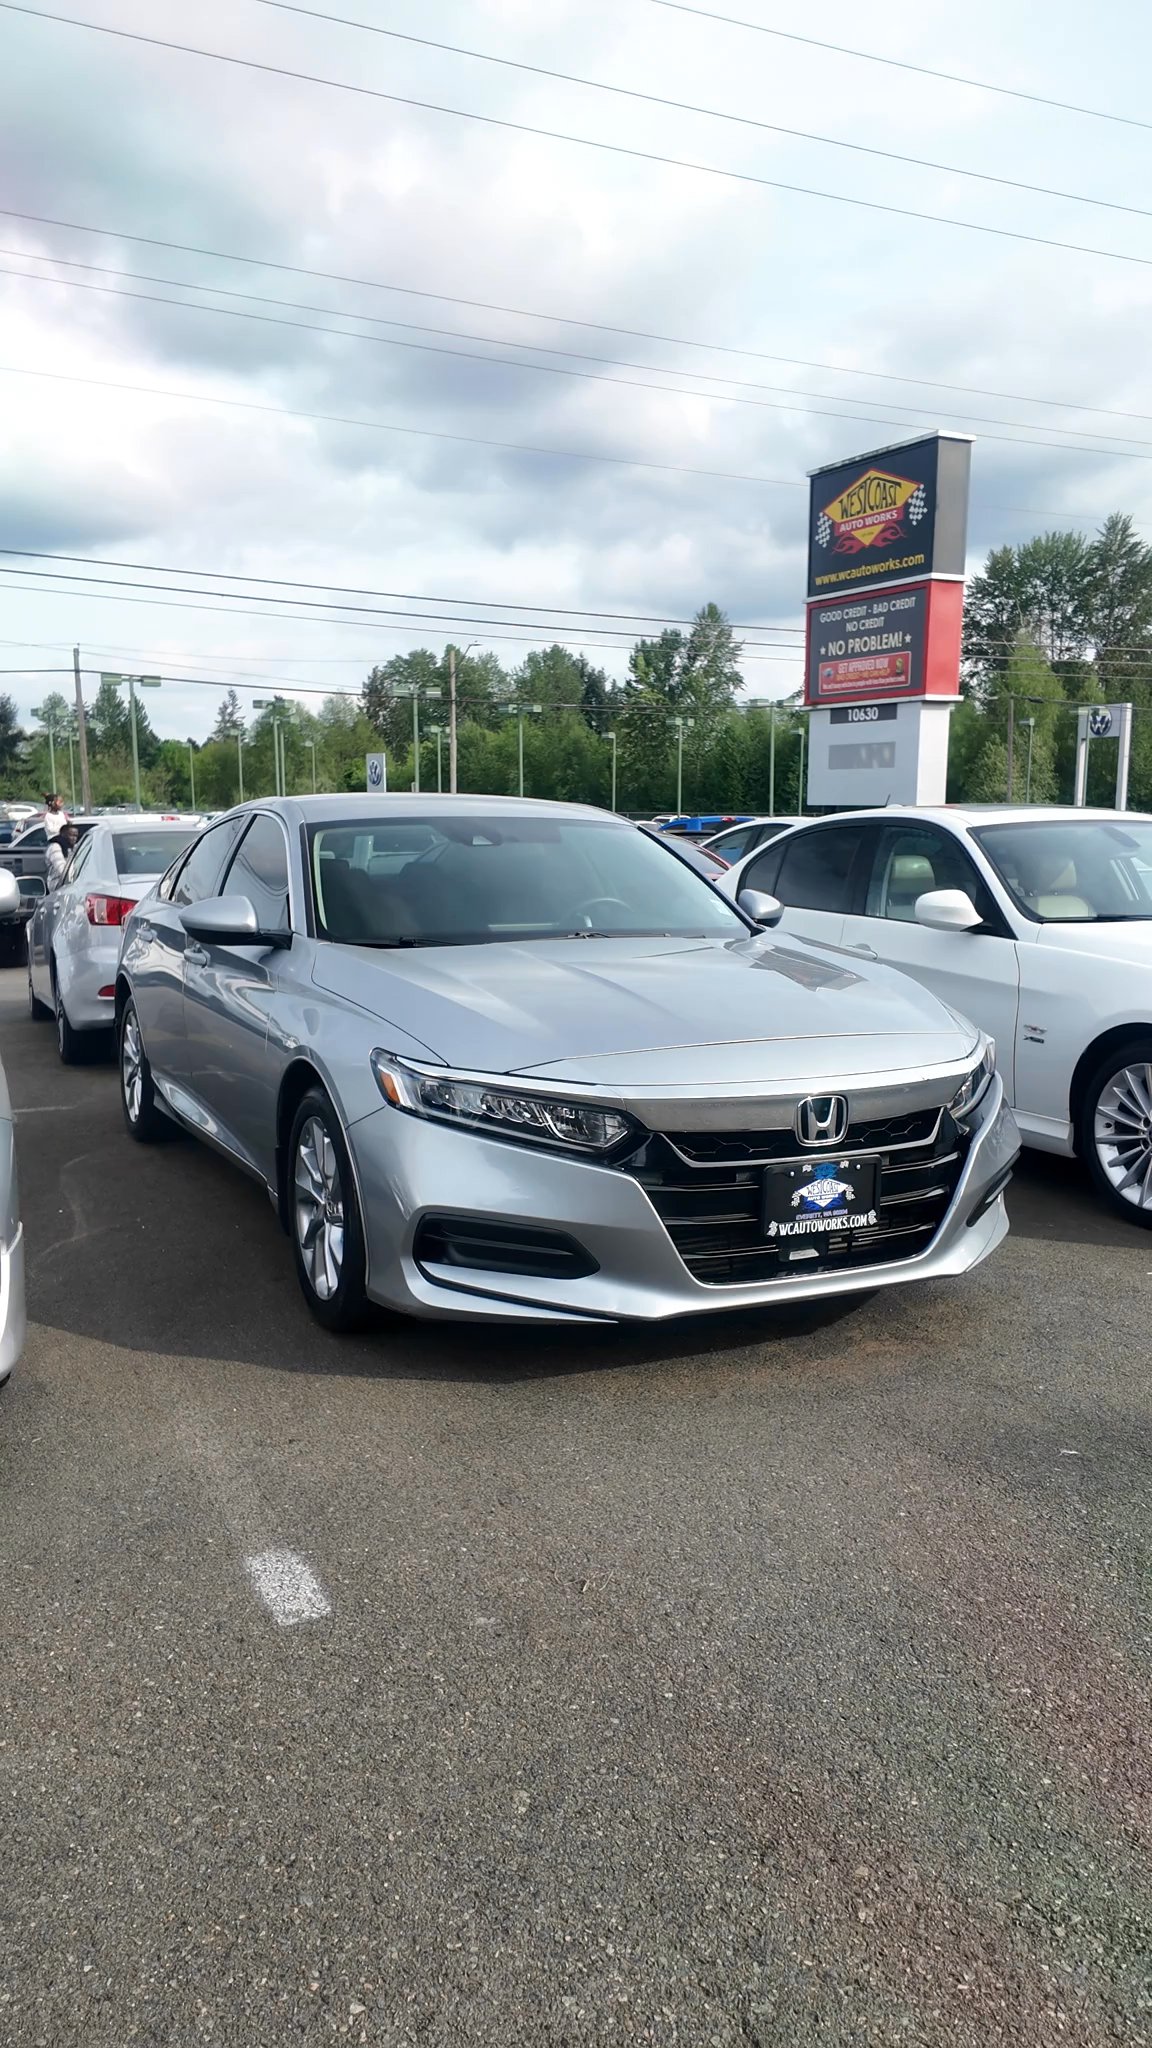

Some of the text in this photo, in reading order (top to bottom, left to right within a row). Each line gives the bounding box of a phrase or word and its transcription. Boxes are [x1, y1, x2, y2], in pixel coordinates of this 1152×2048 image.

[840, 510, 898, 533] AUTO WORKS
[815, 553, 925, 586] www.wcautoworks.com
[820, 610, 842, 623] GOOD
[843, 605, 867, 619] CREDIT
[873, 602, 889, 614] BAD
[890, 597, 916, 611] CREDIT
[845, 616, 885, 632] NO CREDIT
[828, 631, 903, 656] NO PROBLEM!
[847, 706, 879, 721] 10630
[779, 1214, 867, 1236] WCAUTOWORKS.COM
